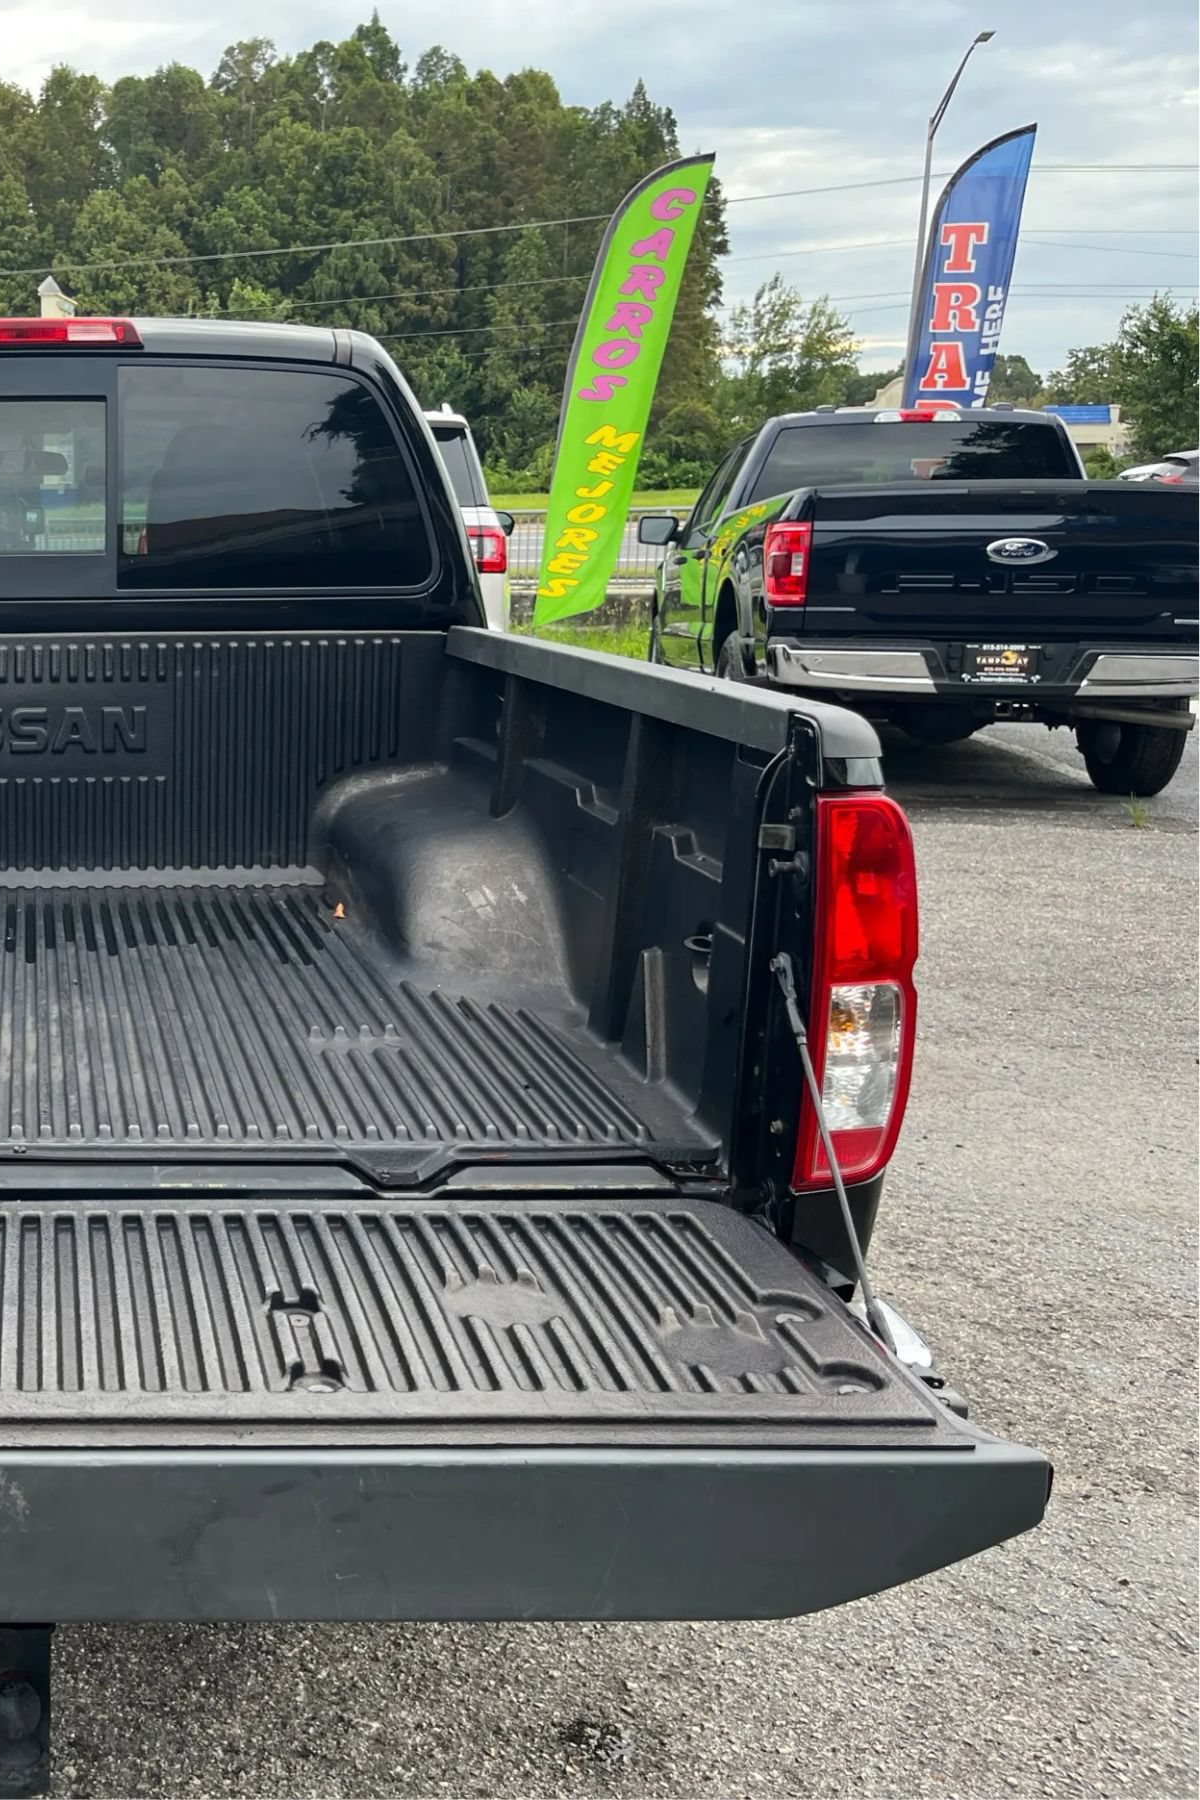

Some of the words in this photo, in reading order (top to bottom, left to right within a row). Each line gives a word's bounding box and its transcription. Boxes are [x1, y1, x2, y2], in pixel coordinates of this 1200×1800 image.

[578, 187, 697, 402] CARROS
[915, 222, 990, 408] TRA
[537, 423, 641, 599] MEJORES
